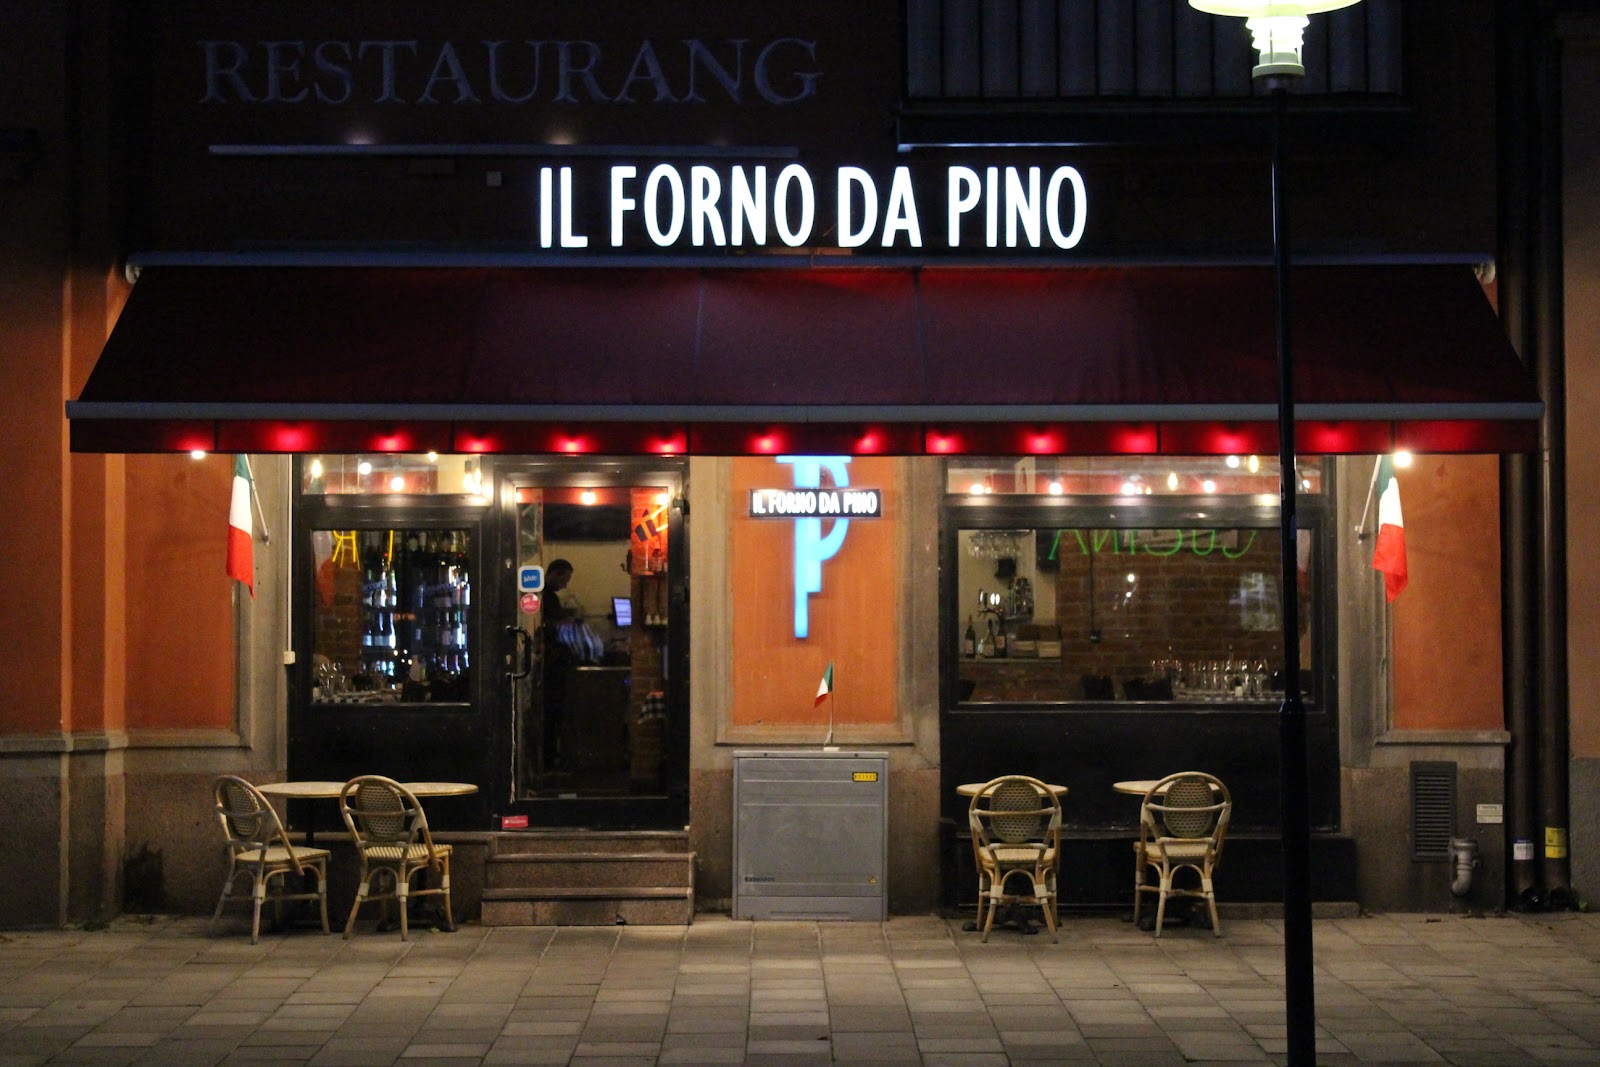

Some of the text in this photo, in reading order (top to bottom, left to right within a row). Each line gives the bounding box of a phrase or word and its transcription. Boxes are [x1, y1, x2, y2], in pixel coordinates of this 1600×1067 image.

[198, 37, 825, 106] RESTAURANG
[539, 163, 1088, 250] IL FORNO DA PINO
[752, 491, 878, 514] IL FORNO DA PINO
